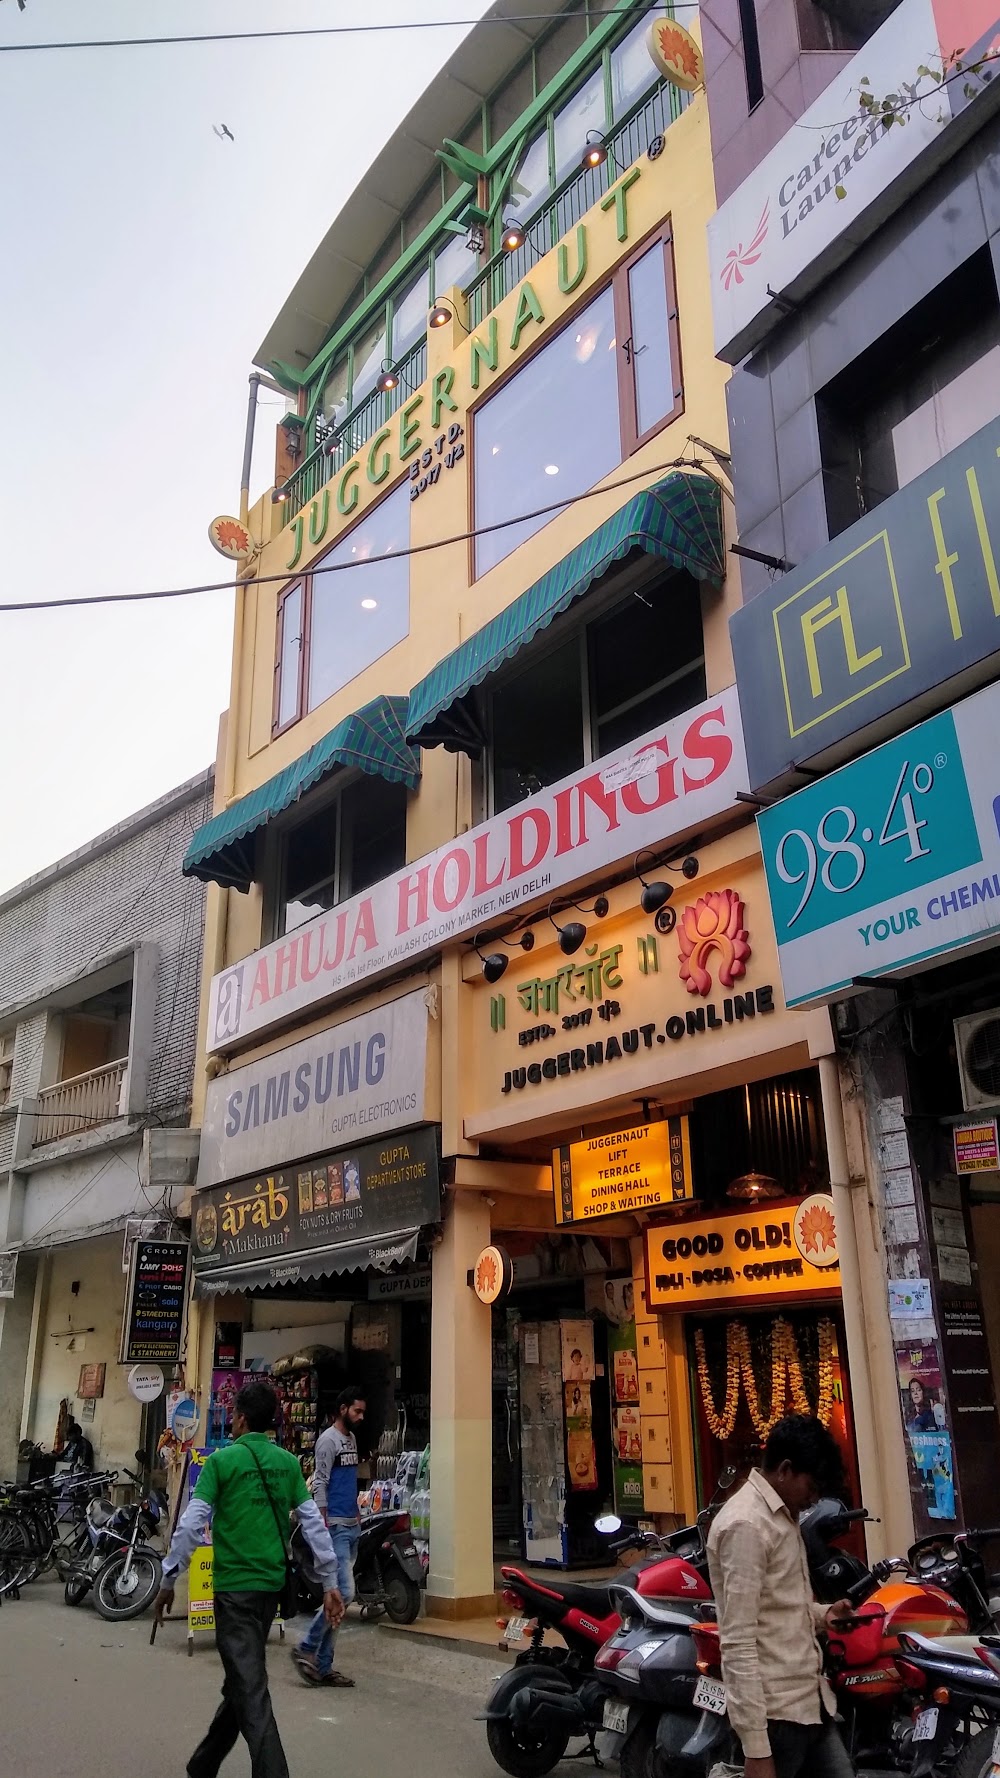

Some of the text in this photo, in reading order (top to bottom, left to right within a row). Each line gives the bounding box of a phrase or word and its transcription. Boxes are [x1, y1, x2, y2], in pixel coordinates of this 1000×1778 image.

[778, 99, 873, 208] Career
[285, 166, 641, 570] JUGGERNAUT
[409, 462, 442, 502] 2017
[246, 704, 734, 1011] AHUJA HOLDINGS
[332, 974, 342, 987] HS
[366, 955, 386, 971] Floor,
[387, 937, 421, 960] KAILASH
[422, 918, 456, 944] COLONY
[457, 900, 496, 927] MARKET,
[498, 889, 520, 909] NEW
[522, 872, 552, 897] DELHI
[857, 907, 921, 947] YOUR
[562, 1007, 593, 1031] 2017
[501, 985, 776, 1094] JUGGERNAUT.ONLINE
[225, 1032, 387, 1138] SAMSUNG
[331, 1093, 418, 1135] GUPTA ELECTRONICS
[587, 1128, 650, 1152] JUGGERNAUT
[379, 1145, 411, 1167] GUPTA
[608, 1149, 628, 1163] LIFT
[366, 1162, 428, 1190] DEPARTMENT STORE
[598, 1162, 642, 1181] TERRACE
[591, 1178, 650, 1199] DINING HALL
[219, 1176, 290, 1239] arab
[583, 1192, 661, 1217] SHOP & WAITING
[299, 1205, 364, 1231] FOX NUTS & DRY FRUITS
[144, 1246, 182, 1256] CROSS
[227, 1230, 285, 1256] Makhana
[374, 1246, 407, 1261] BlackBerry
[661, 1221, 792, 1262] GOOD OLD!
[139, 1263, 160, 1272] LAMY
[275, 1265, 301, 1279] BlackBerry
[655, 1272, 684, 1291] IDLI
[692, 1266, 735, 1287] DOSA
[743, 1258, 803, 1281] COFFEE
[379, 1277, 411, 1295] GUPTA
[141, 1310, 179, 1319] STAEDTLER
[137, 1349, 177, 1357] STATIONERY
[191, 1613, 214, 1627] CASIO
[844, 1675, 860, 1686] HF
[696, 1693, 726, 1711] 5947
